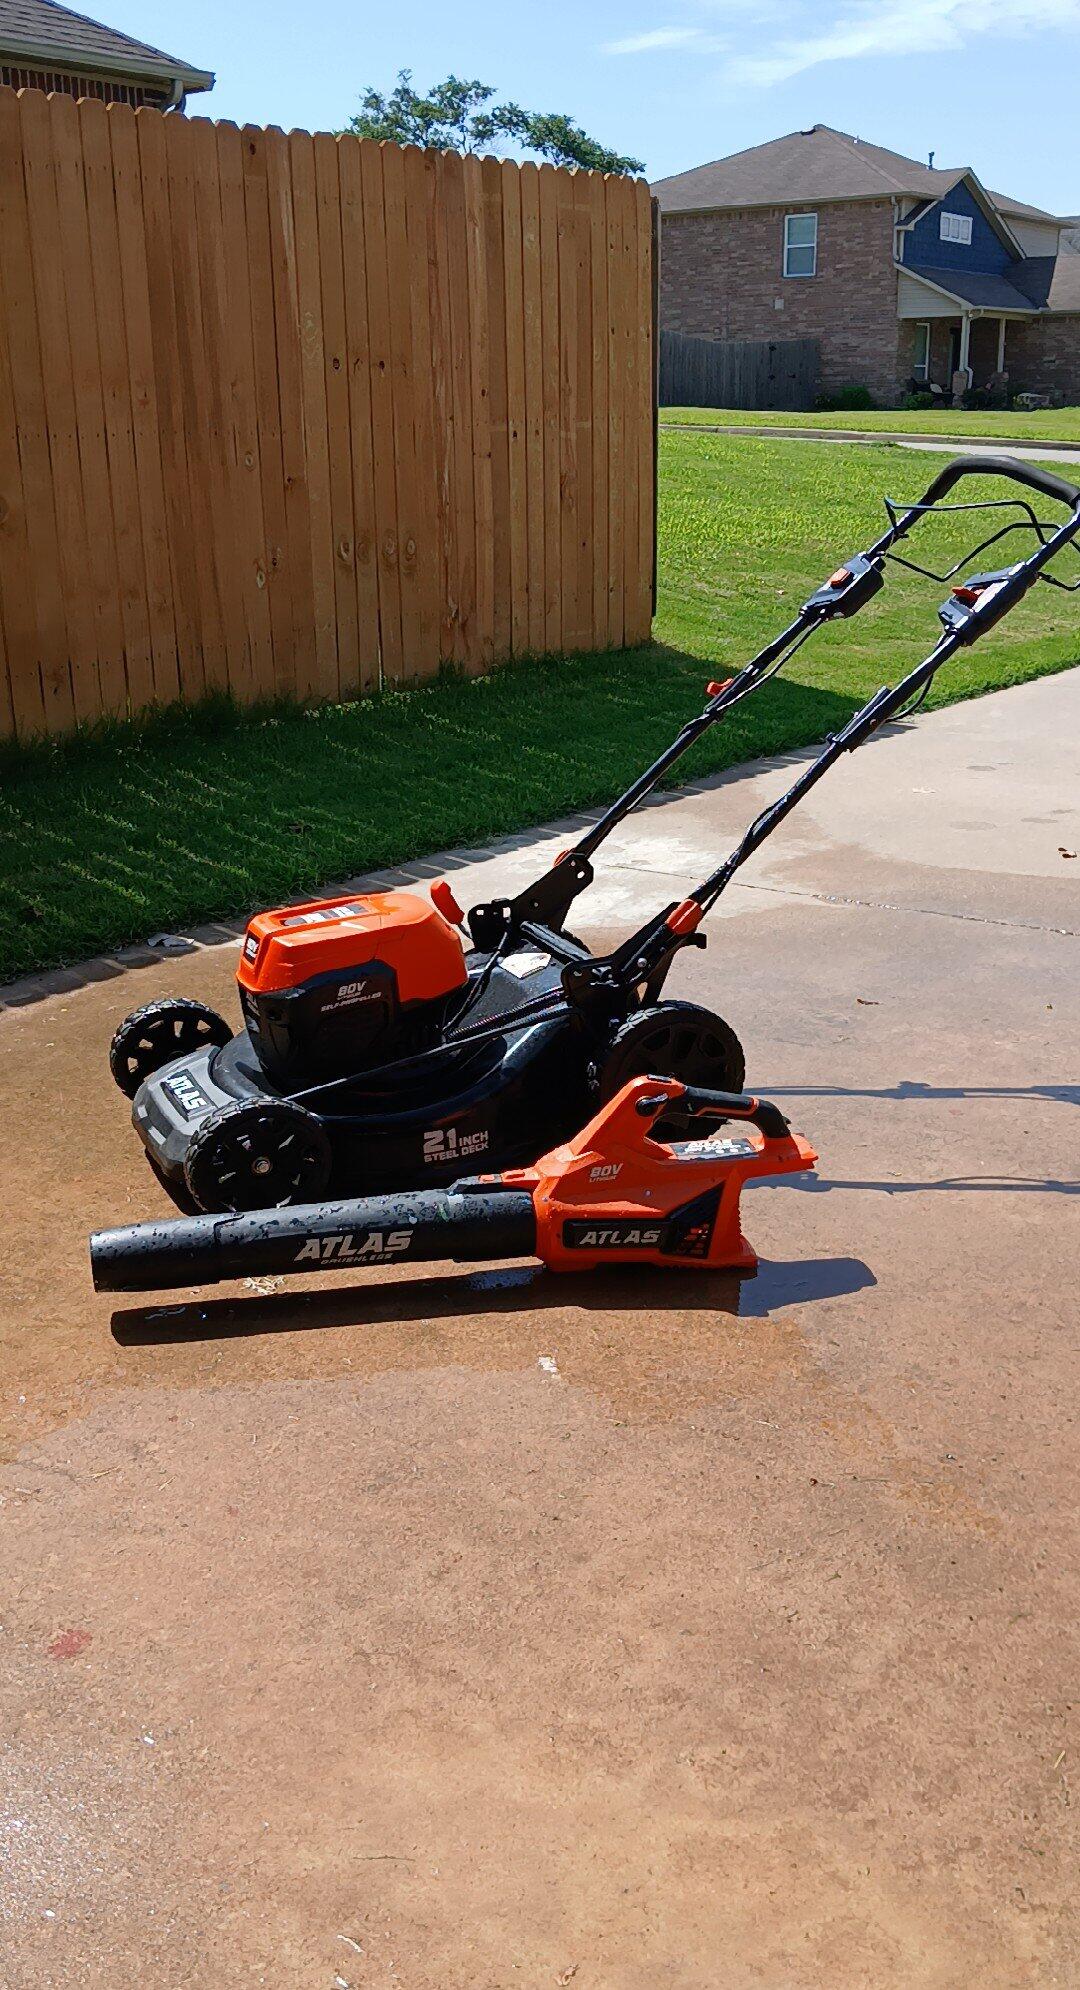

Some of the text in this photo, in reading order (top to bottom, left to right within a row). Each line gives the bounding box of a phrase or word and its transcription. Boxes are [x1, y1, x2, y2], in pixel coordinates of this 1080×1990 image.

[165, 1075, 208, 1111] ATLAS
[423, 1128, 489, 1154] 21 INCH
[424, 1141, 489, 1163] STEEL DECK
[589, 1163, 624, 1178] 80V
[293, 1230, 414, 1262] ATLAS
[579, 1230, 661, 1245] ATLAS
